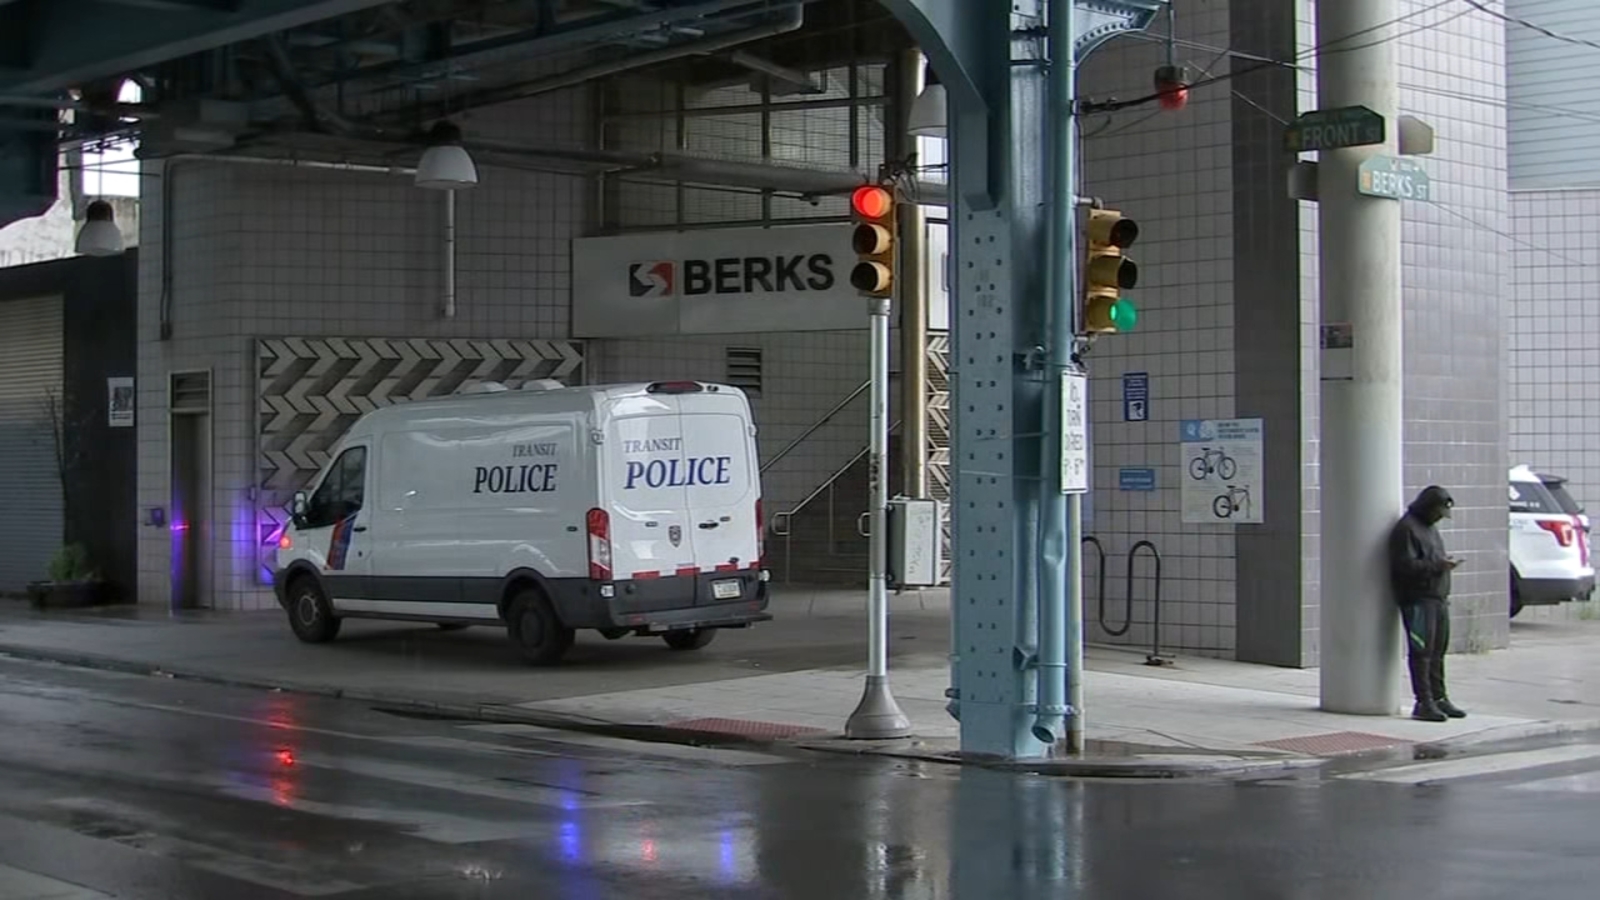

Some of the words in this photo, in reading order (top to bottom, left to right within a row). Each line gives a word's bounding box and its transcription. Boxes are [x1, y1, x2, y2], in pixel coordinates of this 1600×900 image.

[1302, 123, 1360, 147] FRONT
[1373, 170, 1412, 197] BERKS
[1416, 184, 1427, 200] ST
[684, 254, 835, 295] BERKS
[513, 443, 557, 458] TRANSIT
[625, 438, 682, 453] TRANSIT
[473, 464, 557, 493] POLICE
[624, 457, 731, 489] POLICE
